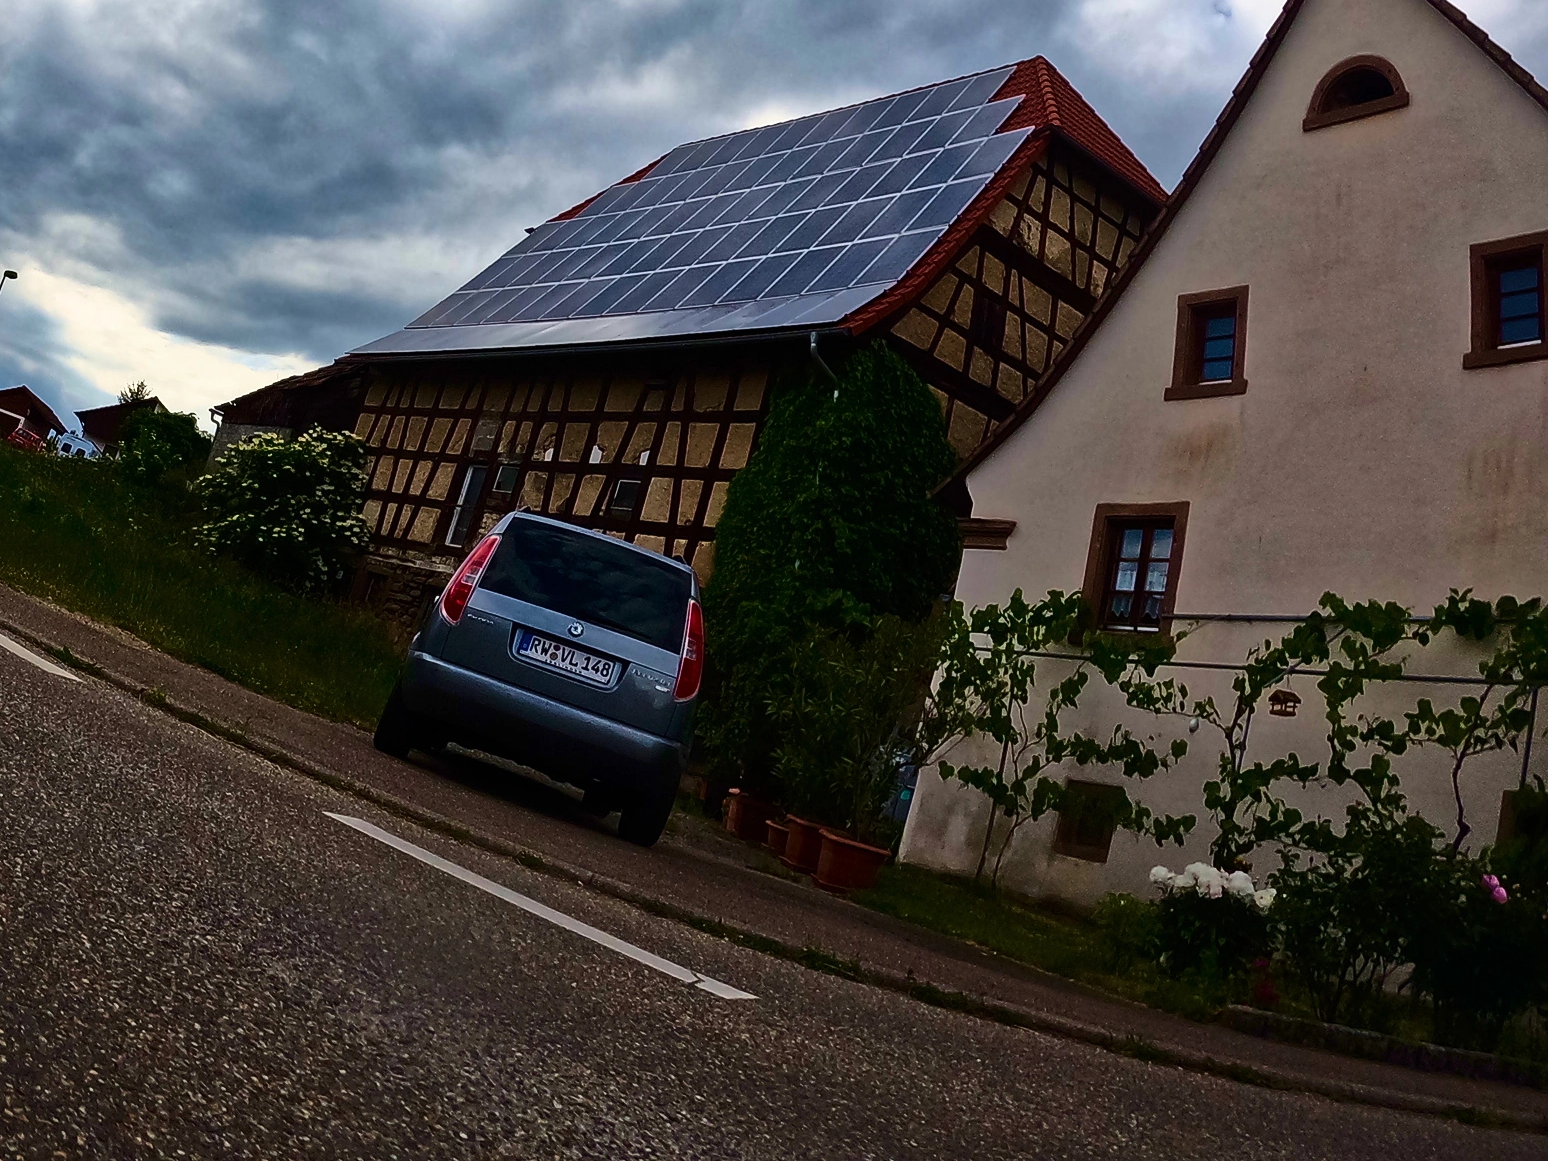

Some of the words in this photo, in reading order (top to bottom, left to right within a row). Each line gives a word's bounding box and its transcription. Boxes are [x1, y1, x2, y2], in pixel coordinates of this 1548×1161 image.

[530, 638, 553, 657] RW
[560, 648, 579, 667] VL
[581, 655, 612, 678] 148
